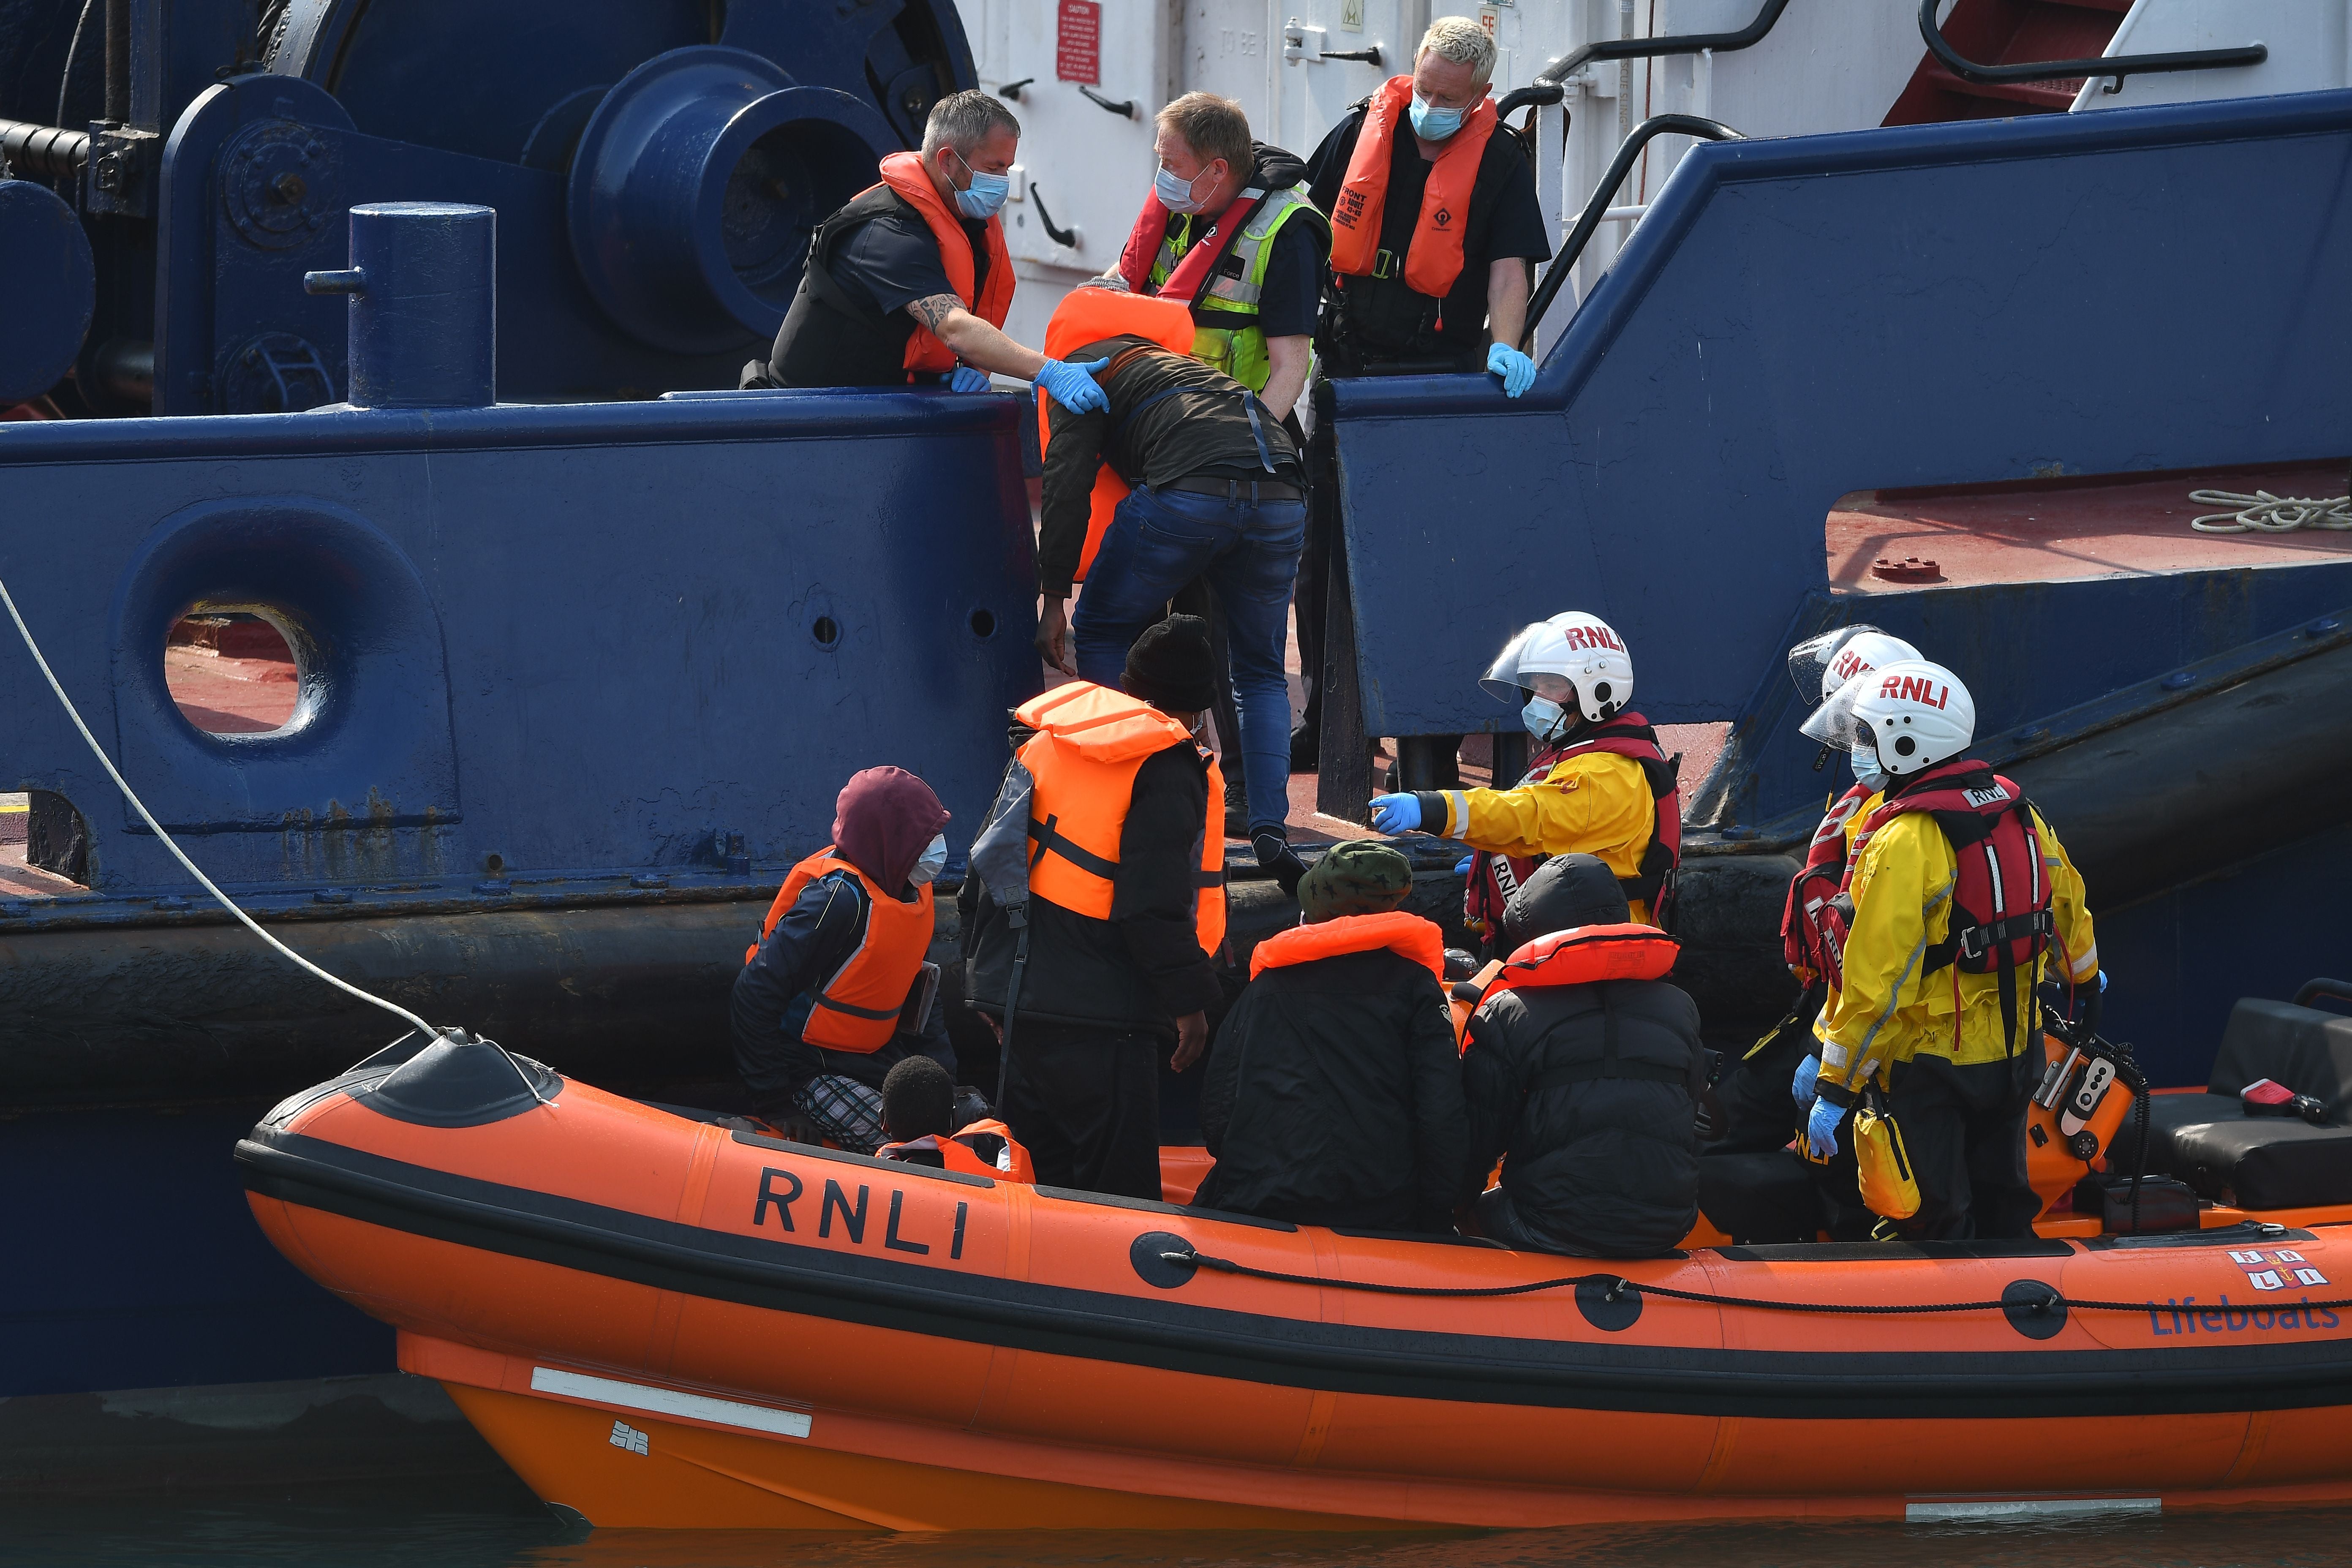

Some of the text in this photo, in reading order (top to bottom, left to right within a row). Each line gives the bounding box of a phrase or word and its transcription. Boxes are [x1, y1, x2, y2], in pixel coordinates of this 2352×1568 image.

[1342, 186, 1367, 202] FRONT
[1348, 198, 1364, 210] ADULT
[1224, 269, 1239, 279] Force
[1564, 626, 1625, 654] RNLI
[1880, 676, 1948, 710] RNLI
[1970, 788, 2006, 803] RNLI
[1494, 861, 1517, 903] RNL
[754, 1166, 968, 1260] RNLI
[2147, 1295, 2340, 1335] Lifeboats
